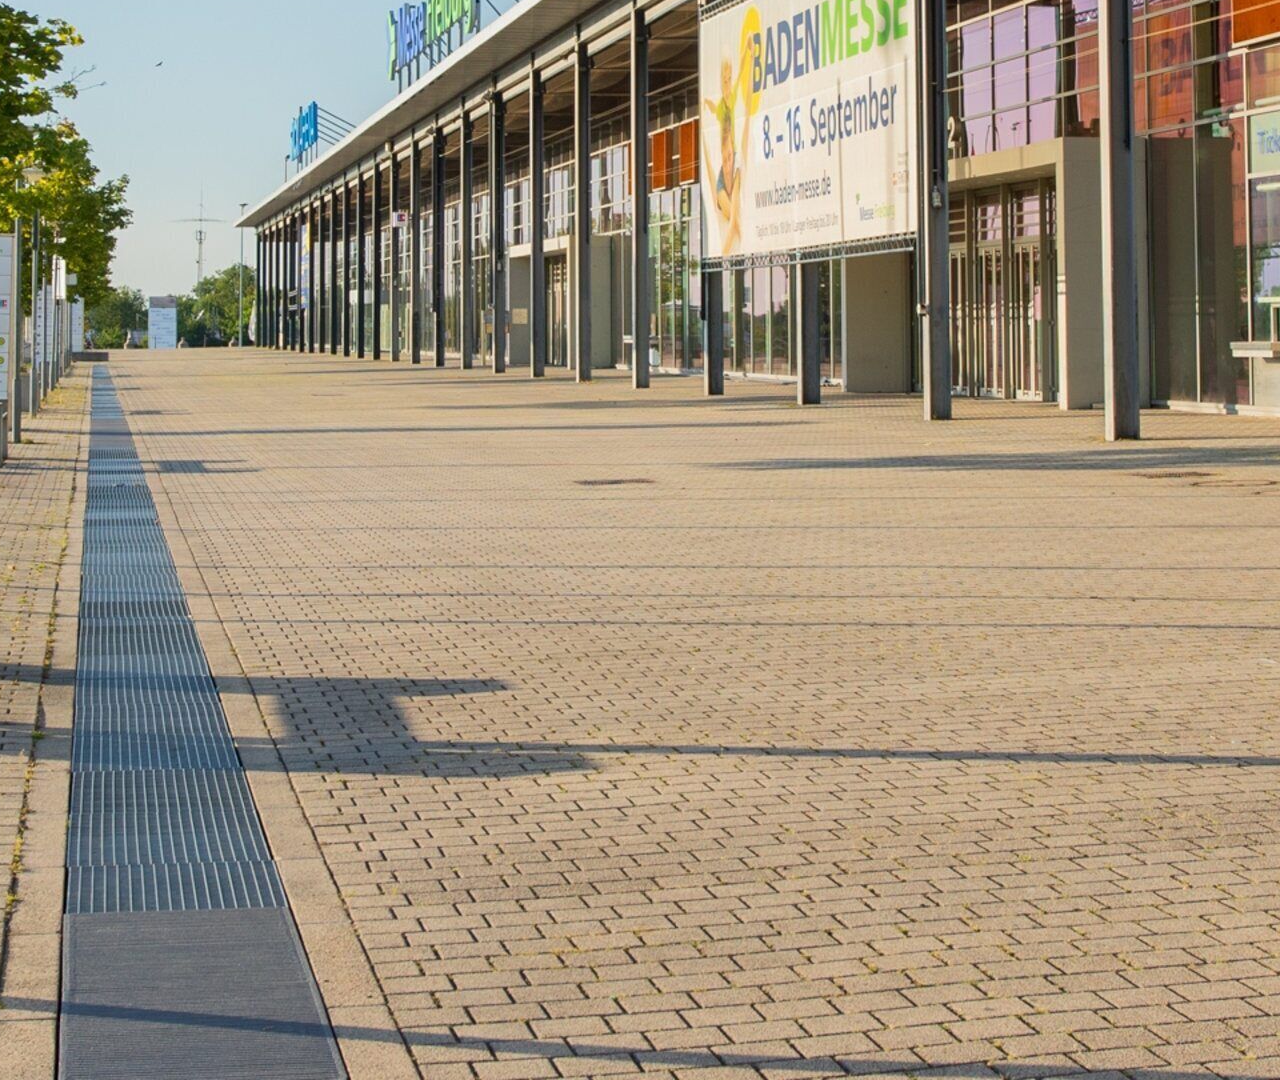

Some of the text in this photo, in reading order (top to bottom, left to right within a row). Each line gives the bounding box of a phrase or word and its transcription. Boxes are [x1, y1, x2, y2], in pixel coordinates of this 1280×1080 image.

[763, 115, 774, 159] 8.
[786, 105, 805, 153] 16.
[810, 76, 897, 156] September
[754, 169, 832, 208] www.baden-messe.de
